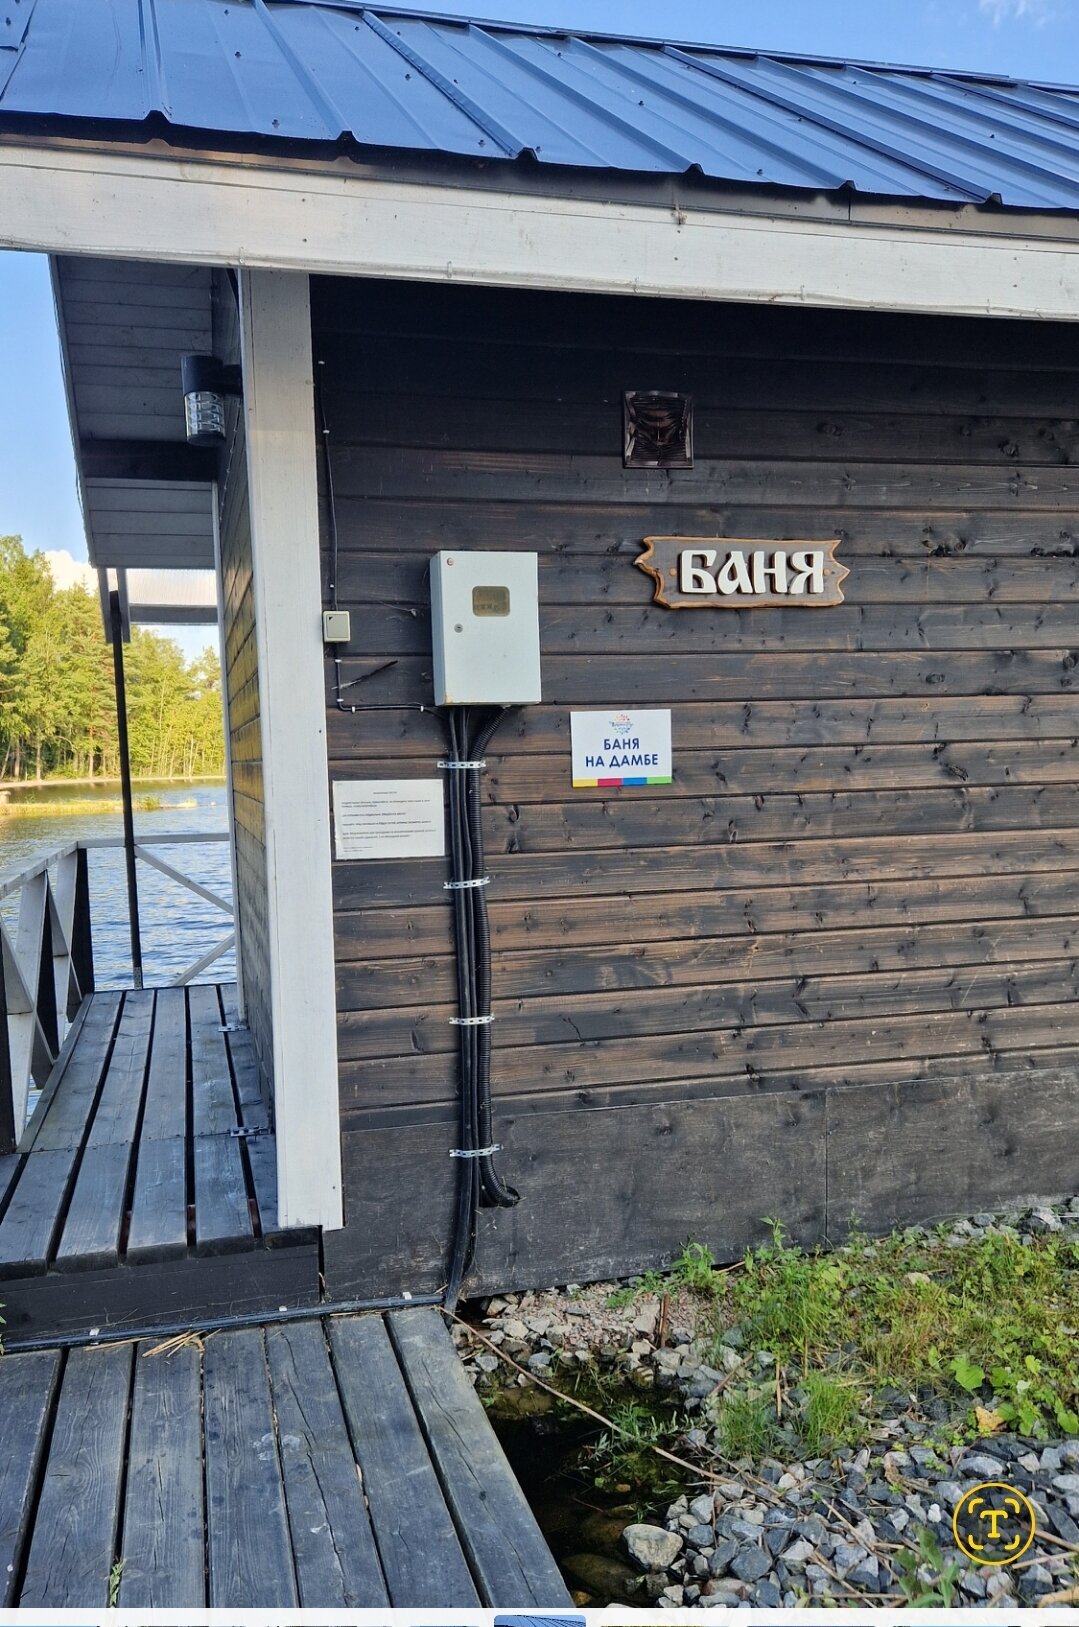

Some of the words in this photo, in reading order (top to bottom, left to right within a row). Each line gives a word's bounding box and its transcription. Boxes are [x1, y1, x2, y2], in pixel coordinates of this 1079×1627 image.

[681, 549, 824, 595] БАНЯ
[604, 738, 640, 751] БАНЯ
[585, 755, 605, 768] НА
[609, 754, 658, 768] ДАМБЕ
